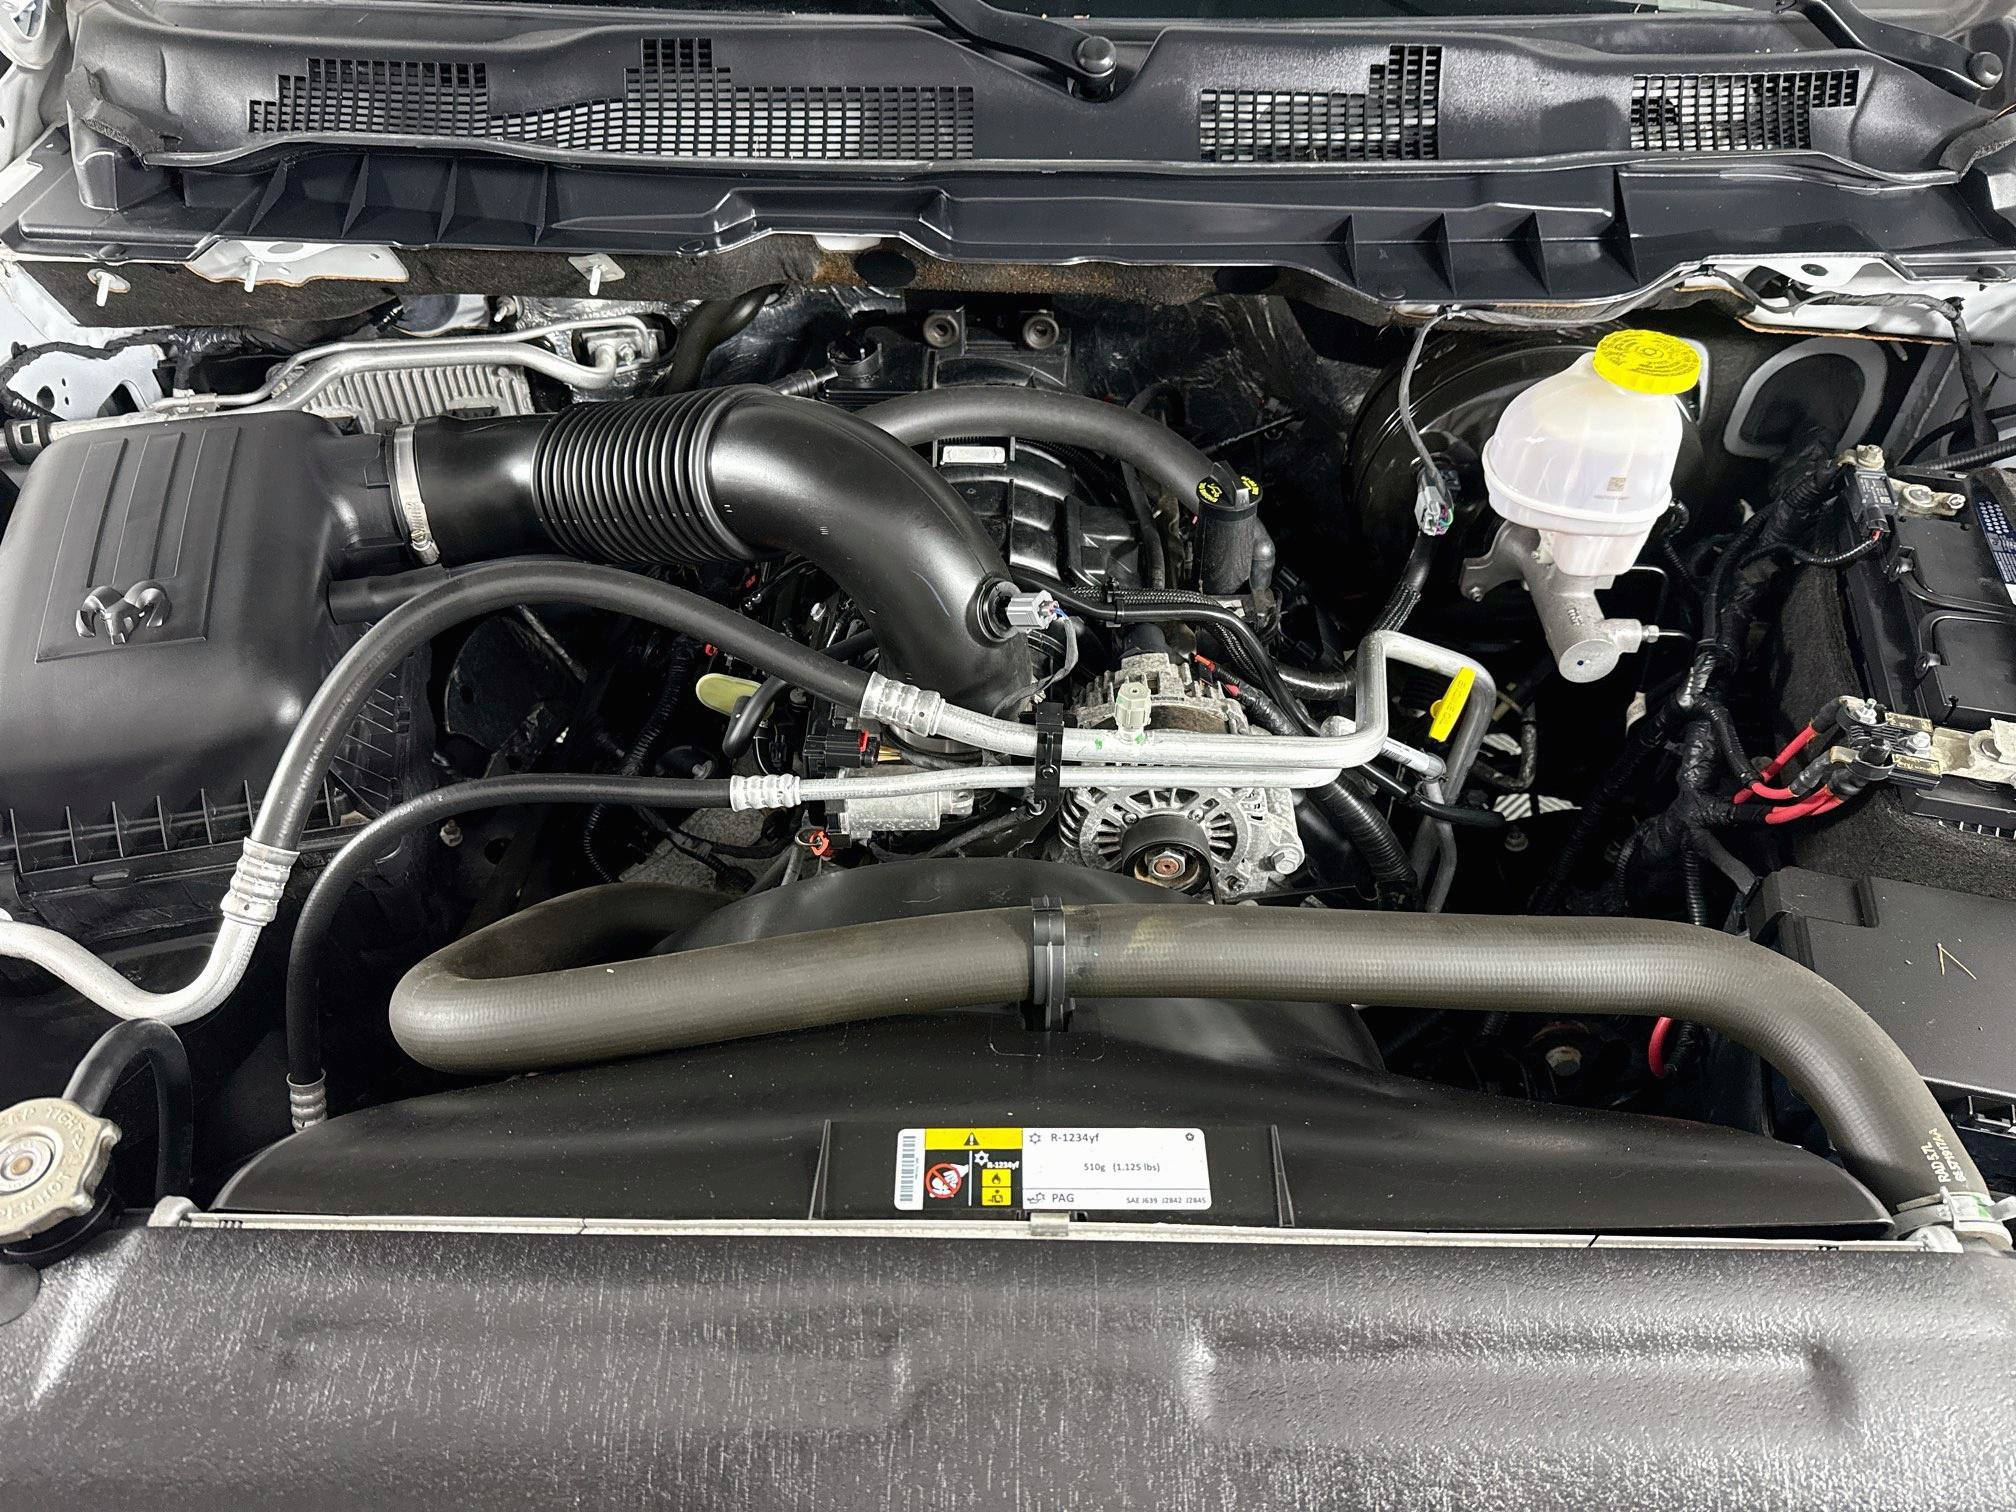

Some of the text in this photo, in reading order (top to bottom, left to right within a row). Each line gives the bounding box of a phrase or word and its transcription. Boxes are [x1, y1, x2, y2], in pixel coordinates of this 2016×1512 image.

[1050, 1132, 1100, 1144] R-1234yf
[1083, 1162, 1161, 1173] 510g (1.125 lbs)
[1931, 1161, 1952, 1183] RAD
[1051, 1193, 1075, 1203] PAG
